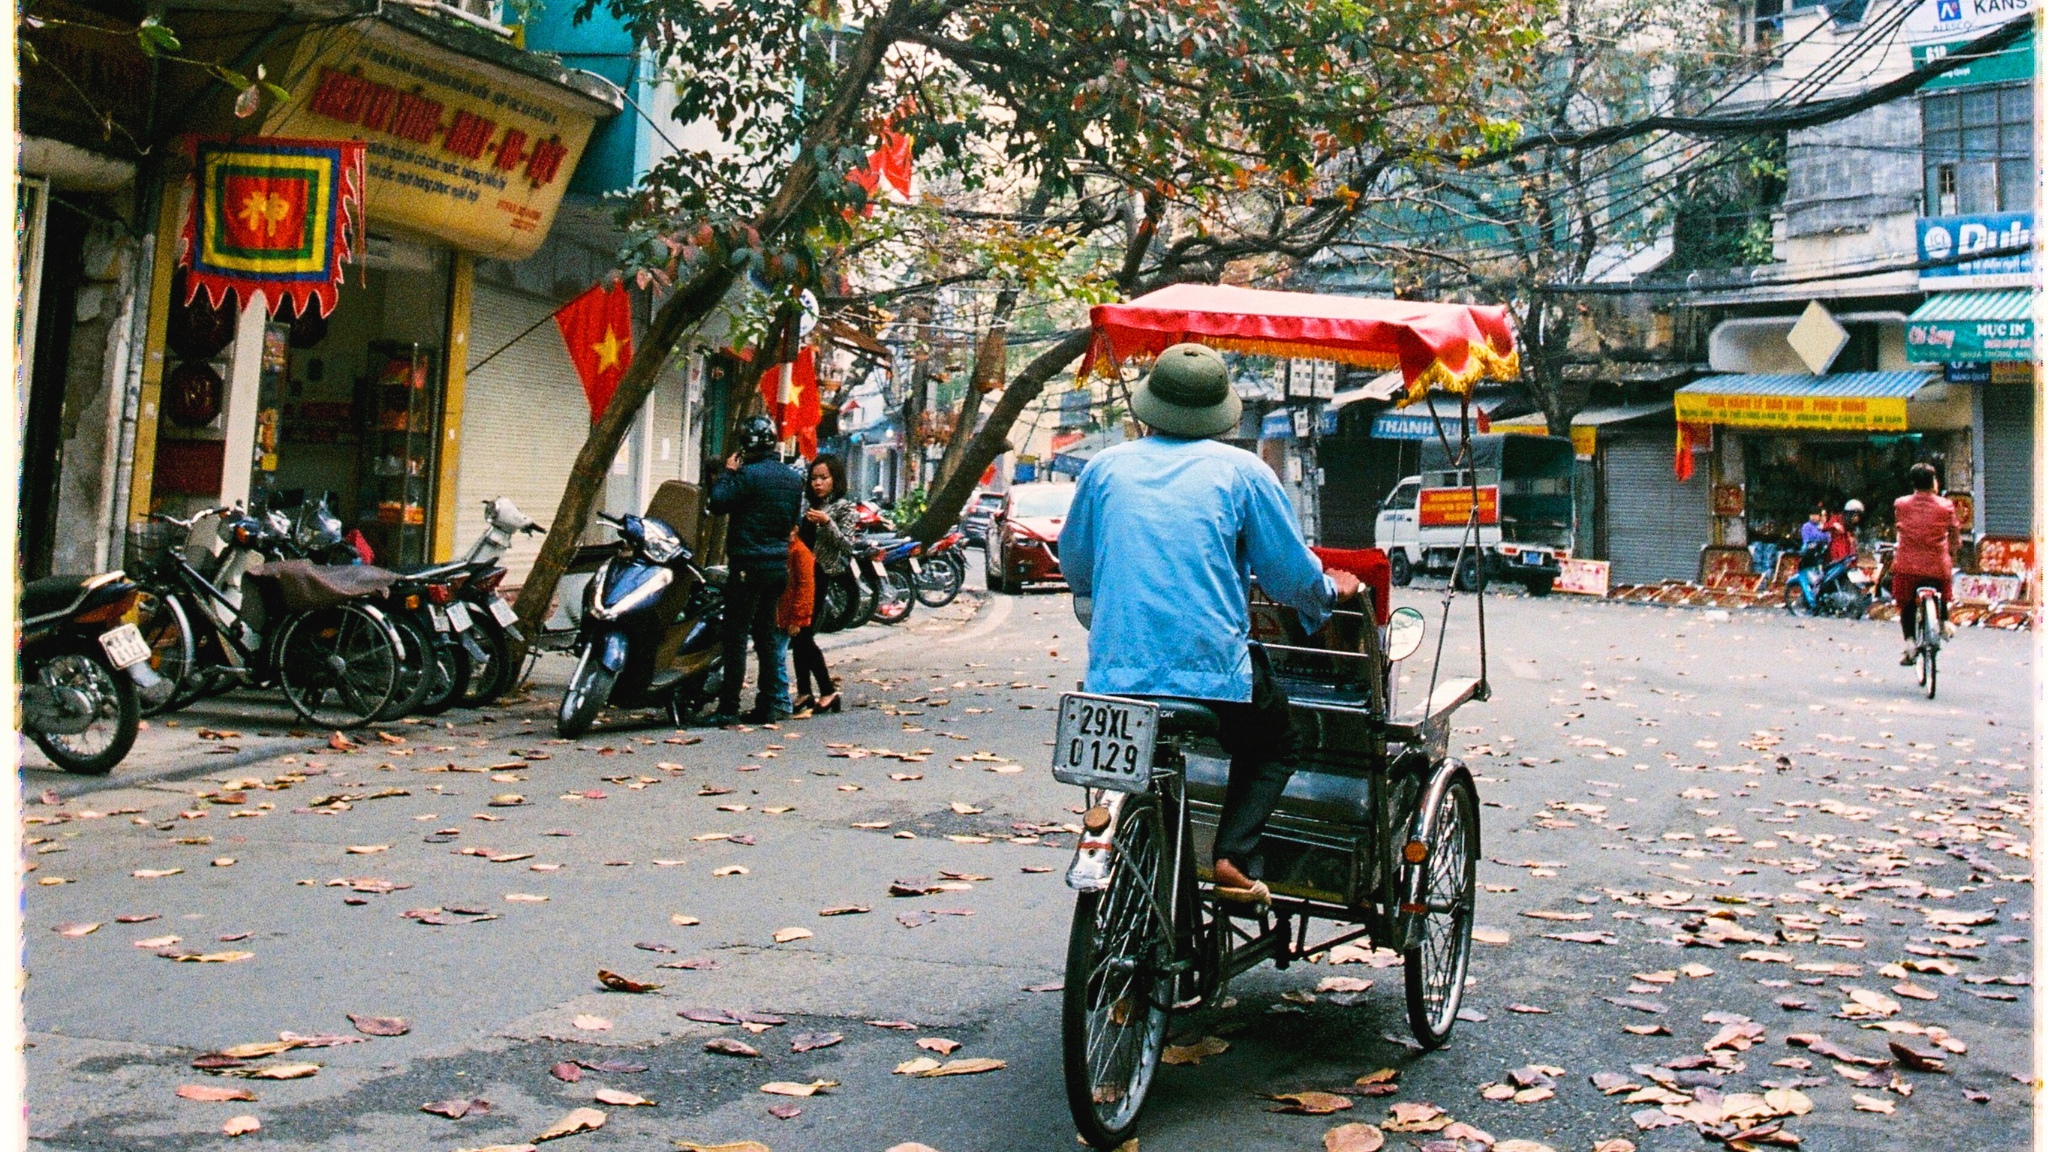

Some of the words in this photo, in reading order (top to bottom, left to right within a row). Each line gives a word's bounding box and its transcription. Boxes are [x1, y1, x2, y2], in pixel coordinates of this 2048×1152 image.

[2009, 323, 2026, 336] IN
[1377, 419, 1434, 435] THANH
[1081, 705, 1133, 740] 29XL
